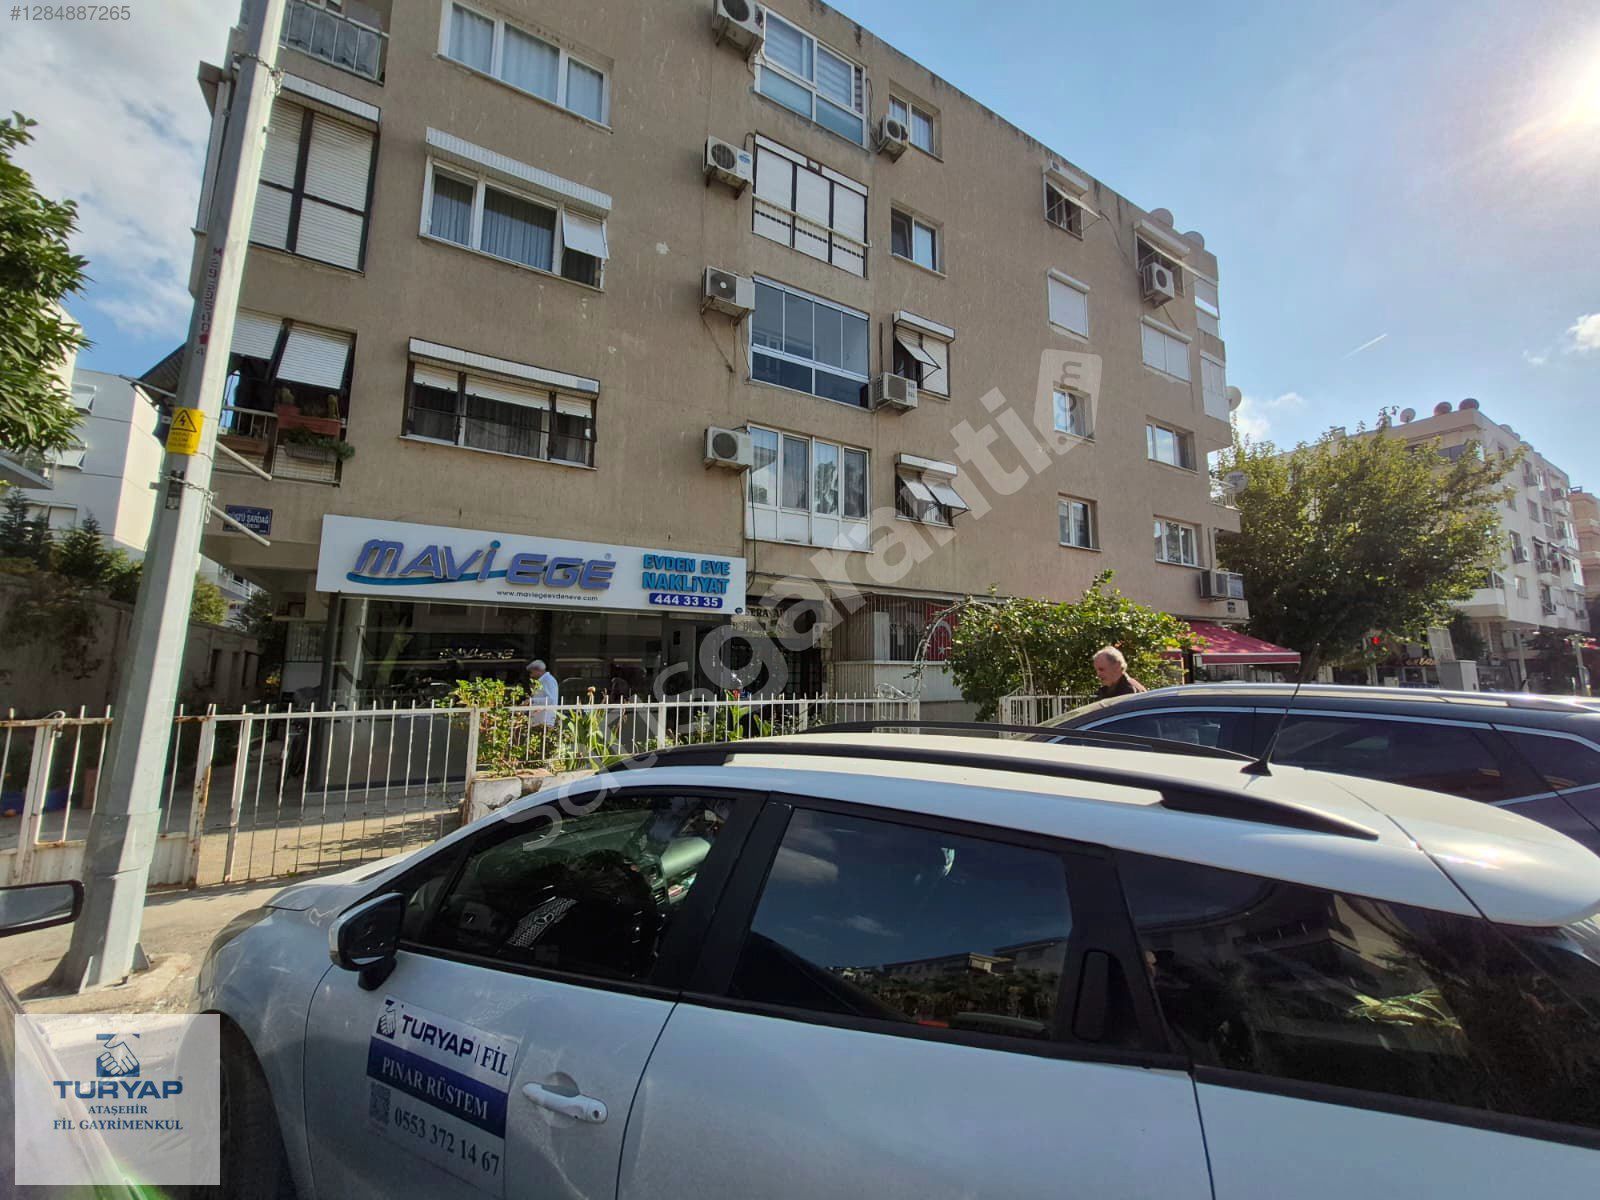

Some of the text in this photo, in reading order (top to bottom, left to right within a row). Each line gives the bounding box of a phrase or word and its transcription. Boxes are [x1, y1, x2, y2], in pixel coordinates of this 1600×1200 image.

[506, 553, 616, 590] EGE
[643, 554, 731, 576] EVDEN EVE
[654, 594, 718, 607] 444 33 35
[402, 1014, 508, 1076] TURYAP FİL
[382, 1057, 489, 1120] PINAR RÜSTEM
[394, 1107, 500, 1176] 0553 372 14 67
